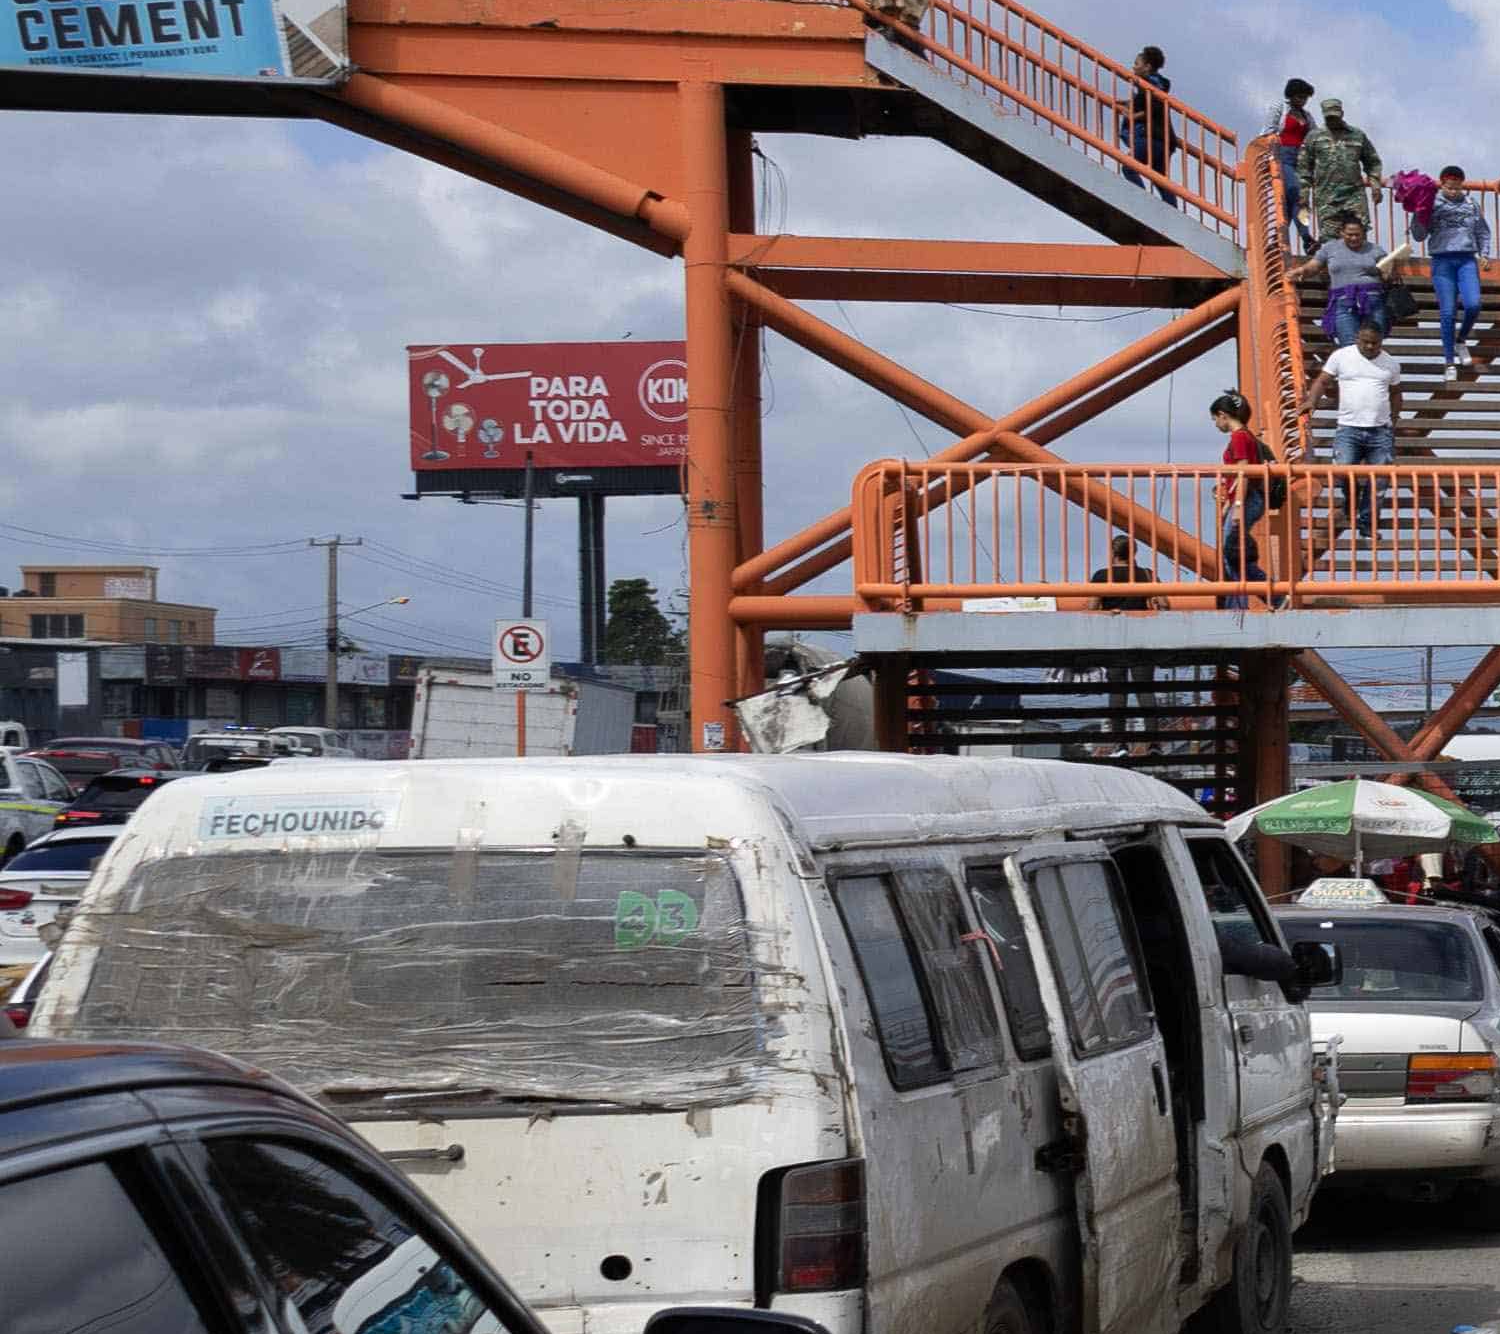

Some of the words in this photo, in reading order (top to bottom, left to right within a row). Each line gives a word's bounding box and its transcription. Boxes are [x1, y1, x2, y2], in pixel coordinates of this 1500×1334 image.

[530, 376, 609, 398] PARA
[647, 378, 688, 404] KDK
[529, 400, 611, 421] TODA
[514, 422, 552, 444] LA
[559, 421, 628, 443] VIDA
[640, 434, 676, 446] SINCE
[510, 672, 531, 682] NO
